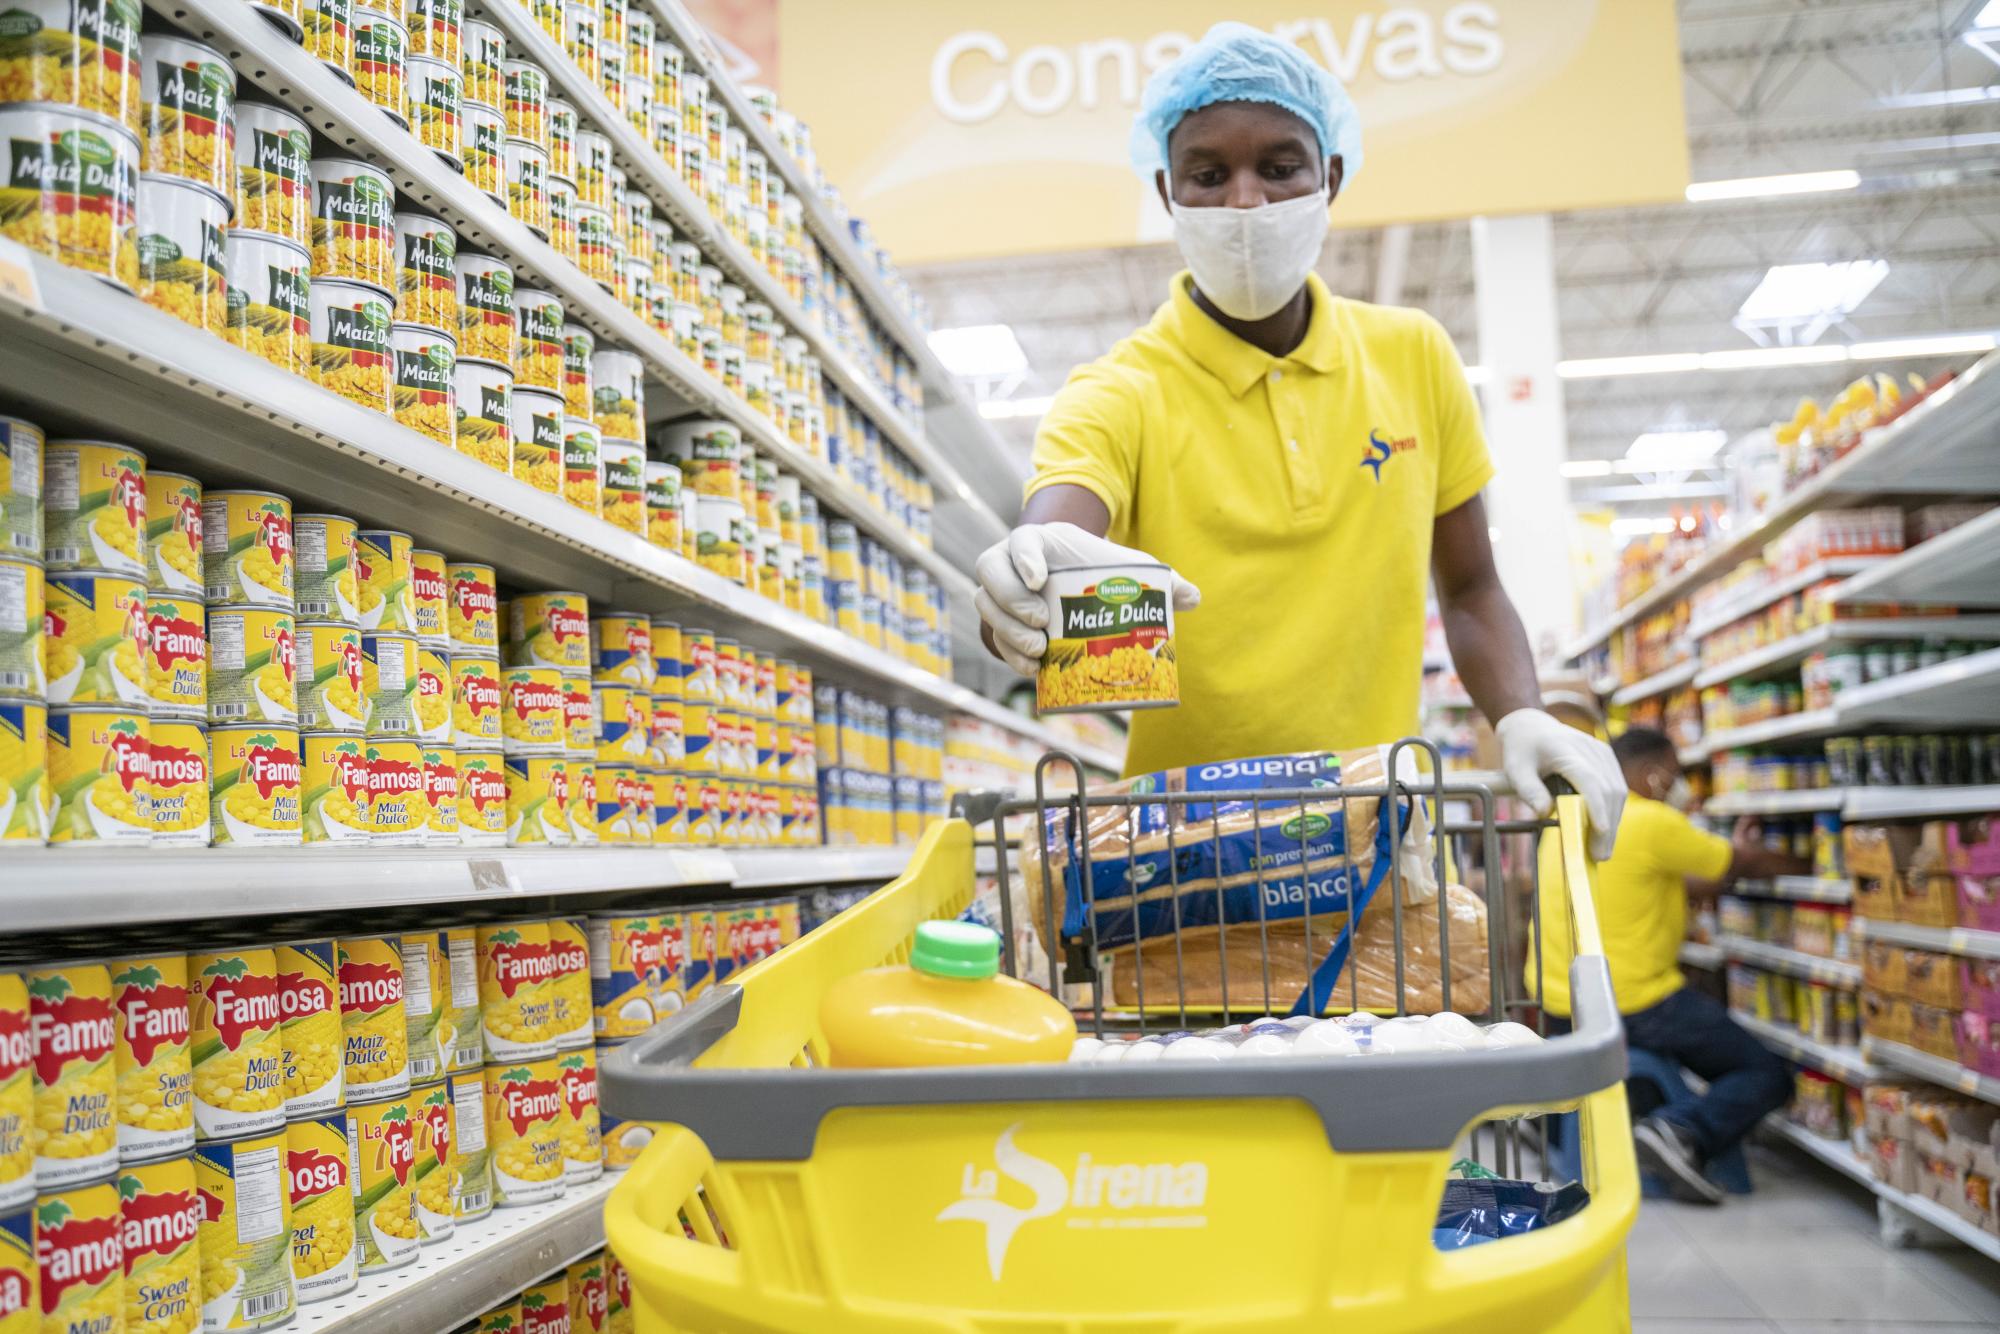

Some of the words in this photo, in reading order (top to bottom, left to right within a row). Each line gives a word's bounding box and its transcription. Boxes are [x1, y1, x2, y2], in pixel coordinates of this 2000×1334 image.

[165, 79, 213, 109] Maíz
[18, 157, 81, 182] Maíz
[326, 195, 369, 216] Maíz
[411, 247, 445, 269] Maíz
[470, 286, 503, 306] Maíz
[335, 321, 376, 342] Maíz
[525, 319, 555, 337] Maíz
[565, 352, 582, 367] aíz
[403, 362, 440, 383] Maíz
[565, 451, 586, 465] aíz
[102, 463, 118, 478] La
[166, 491, 180, 506] La
[247, 508, 261, 521] La
[114, 594, 129, 610] La
[459, 586, 497, 612] Famo
[1068, 606, 1114, 631] Maíz
[1120, 601, 1164, 625] Dulce
[263, 626, 276, 639] La
[330, 640, 342, 653] La
[92, 729, 109, 745] La
[231, 745, 246, 759] La
[322, 750, 336, 764] La
[1200, 758, 1317, 781] blanco
[368, 770, 423, 790] amosa
[375, 813, 410, 826] Dulce
[1249, 854, 1275, 869] pn
[1262, 876, 1348, 907] blanco
[280, 986, 326, 1014] osa
[339, 977, 404, 1005] amosa
[126, 1000, 190, 1039] Famo
[344, 1050, 388, 1067] Dulce
[365, 1122, 381, 1140] La
[960, 1163, 998, 1197] La
[293, 1224, 316, 1243] eet
[137, 1276, 189, 1305] Sweet
[144, 1298, 187, 1322] Corn
